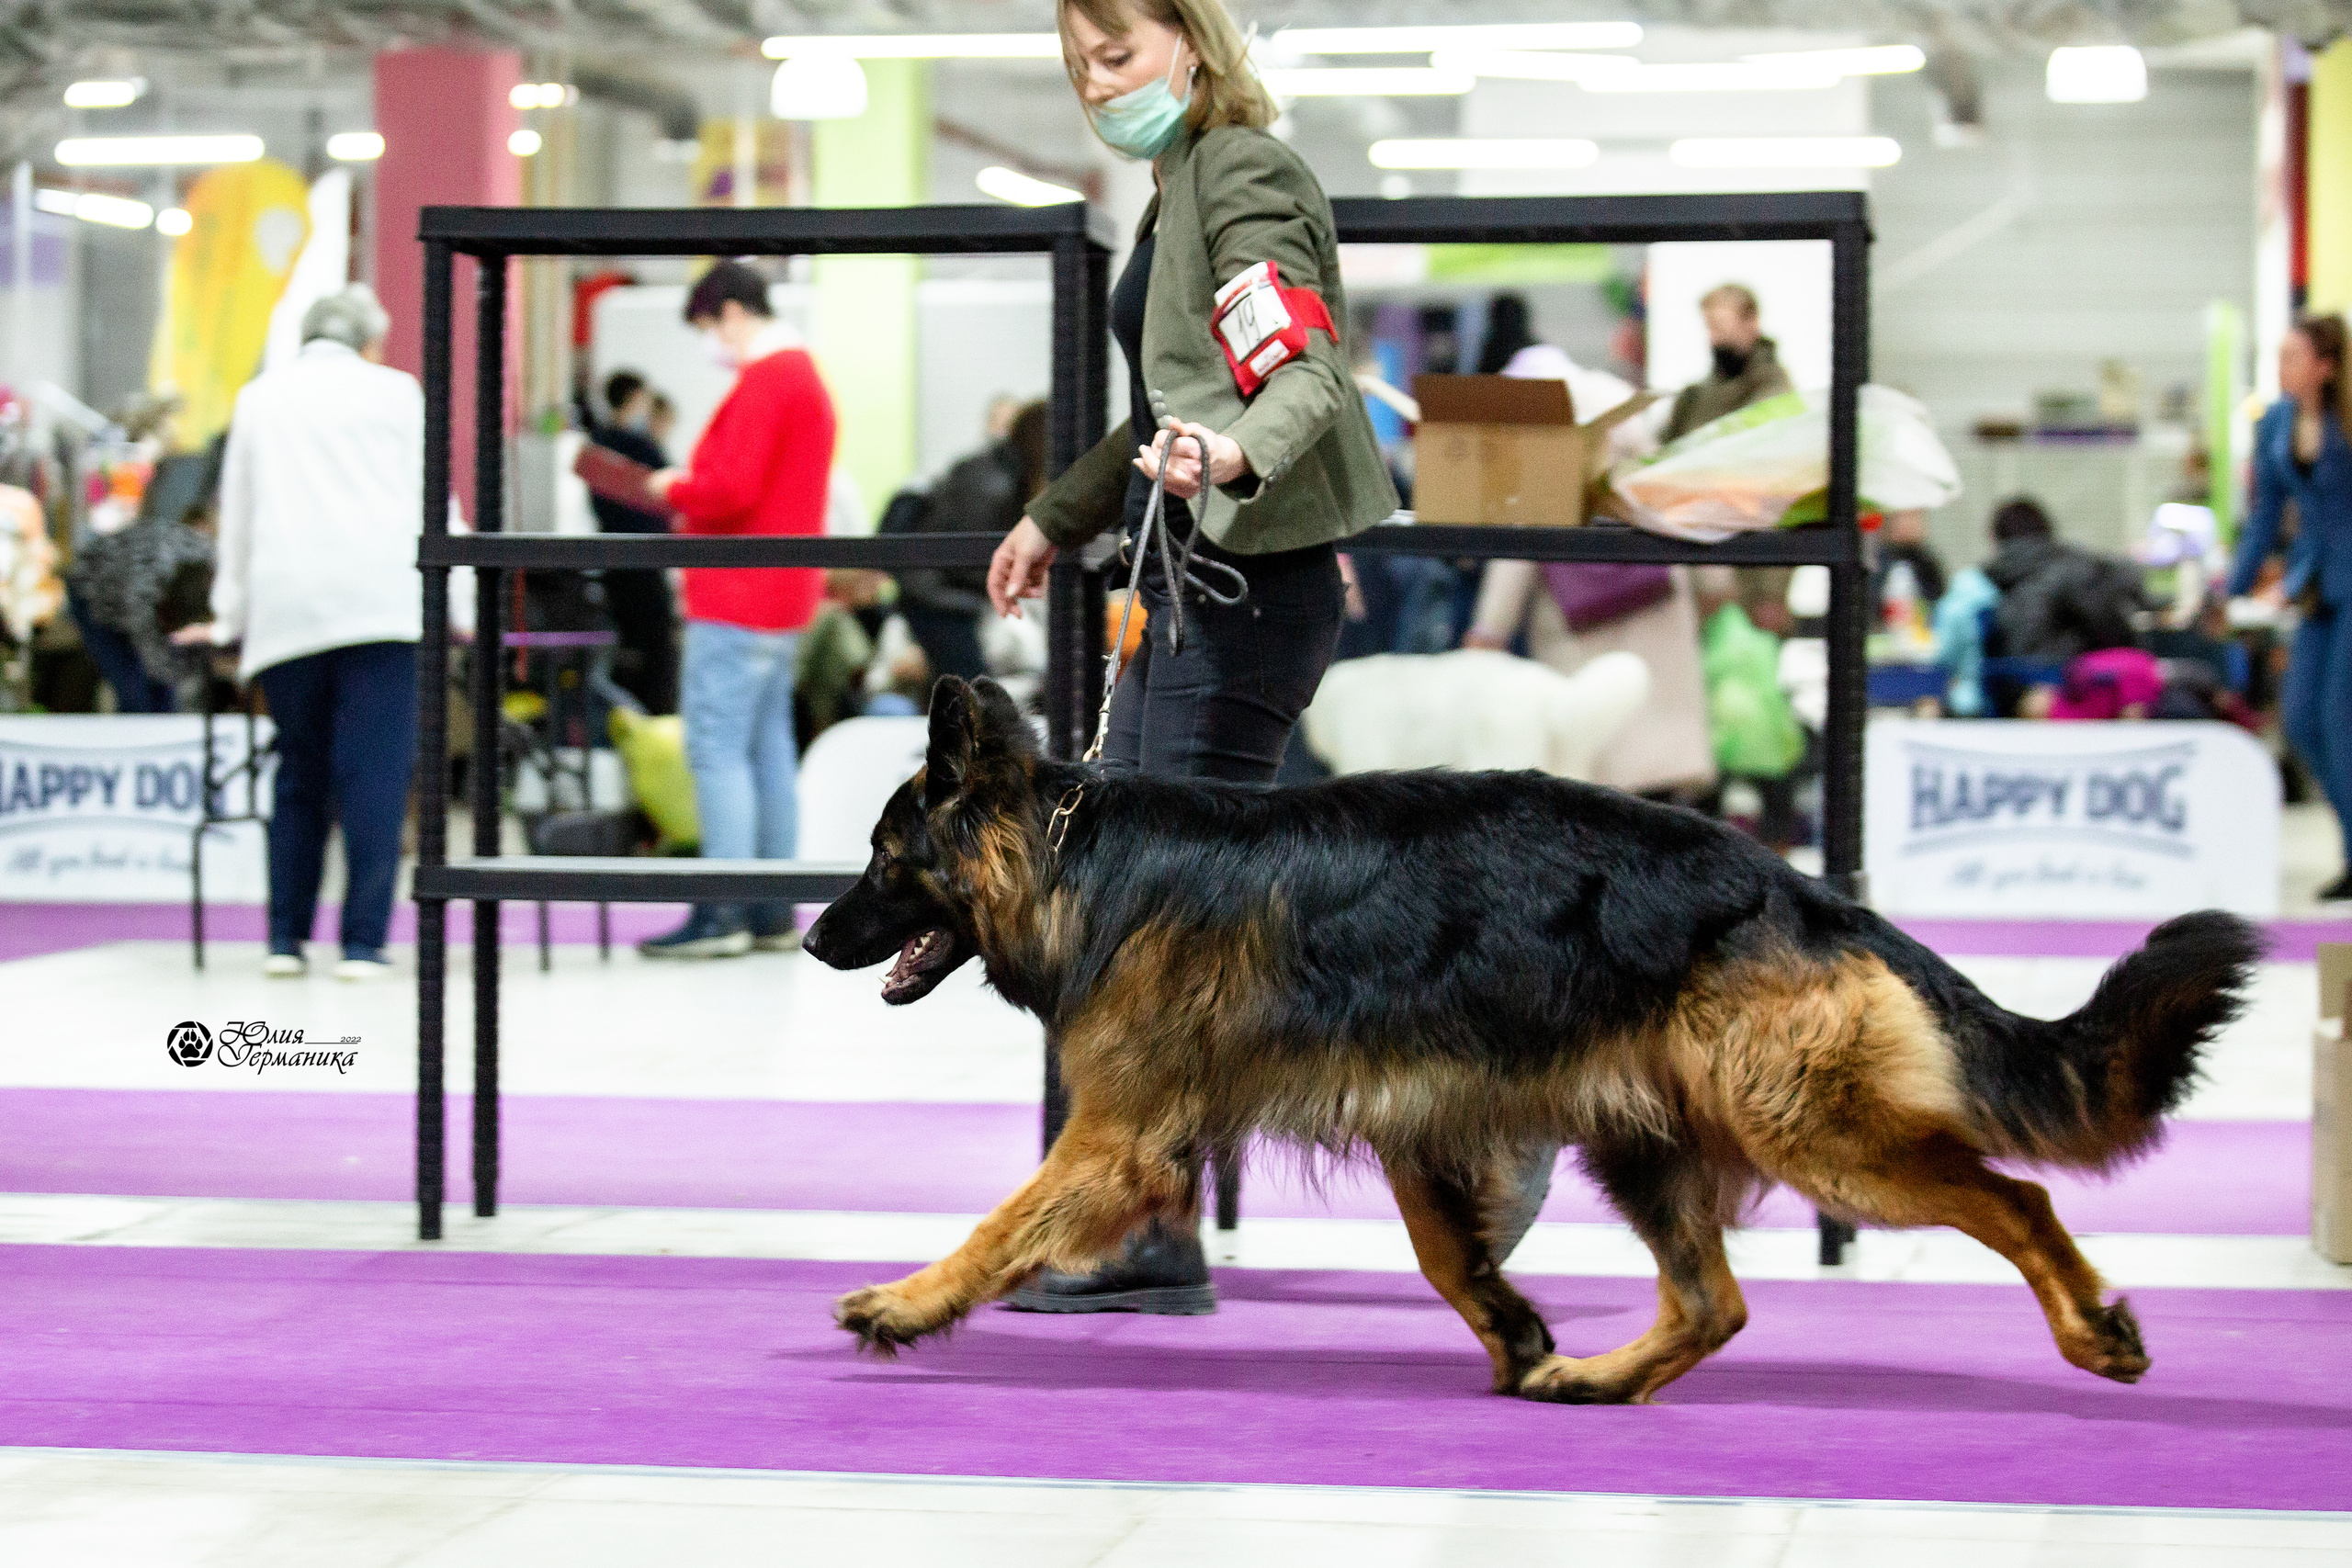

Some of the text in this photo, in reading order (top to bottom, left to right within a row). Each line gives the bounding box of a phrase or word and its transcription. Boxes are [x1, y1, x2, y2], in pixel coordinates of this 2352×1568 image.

[0, 759, 122, 816] APPY
[1910, 763, 2187, 833] HAPPY DOG
